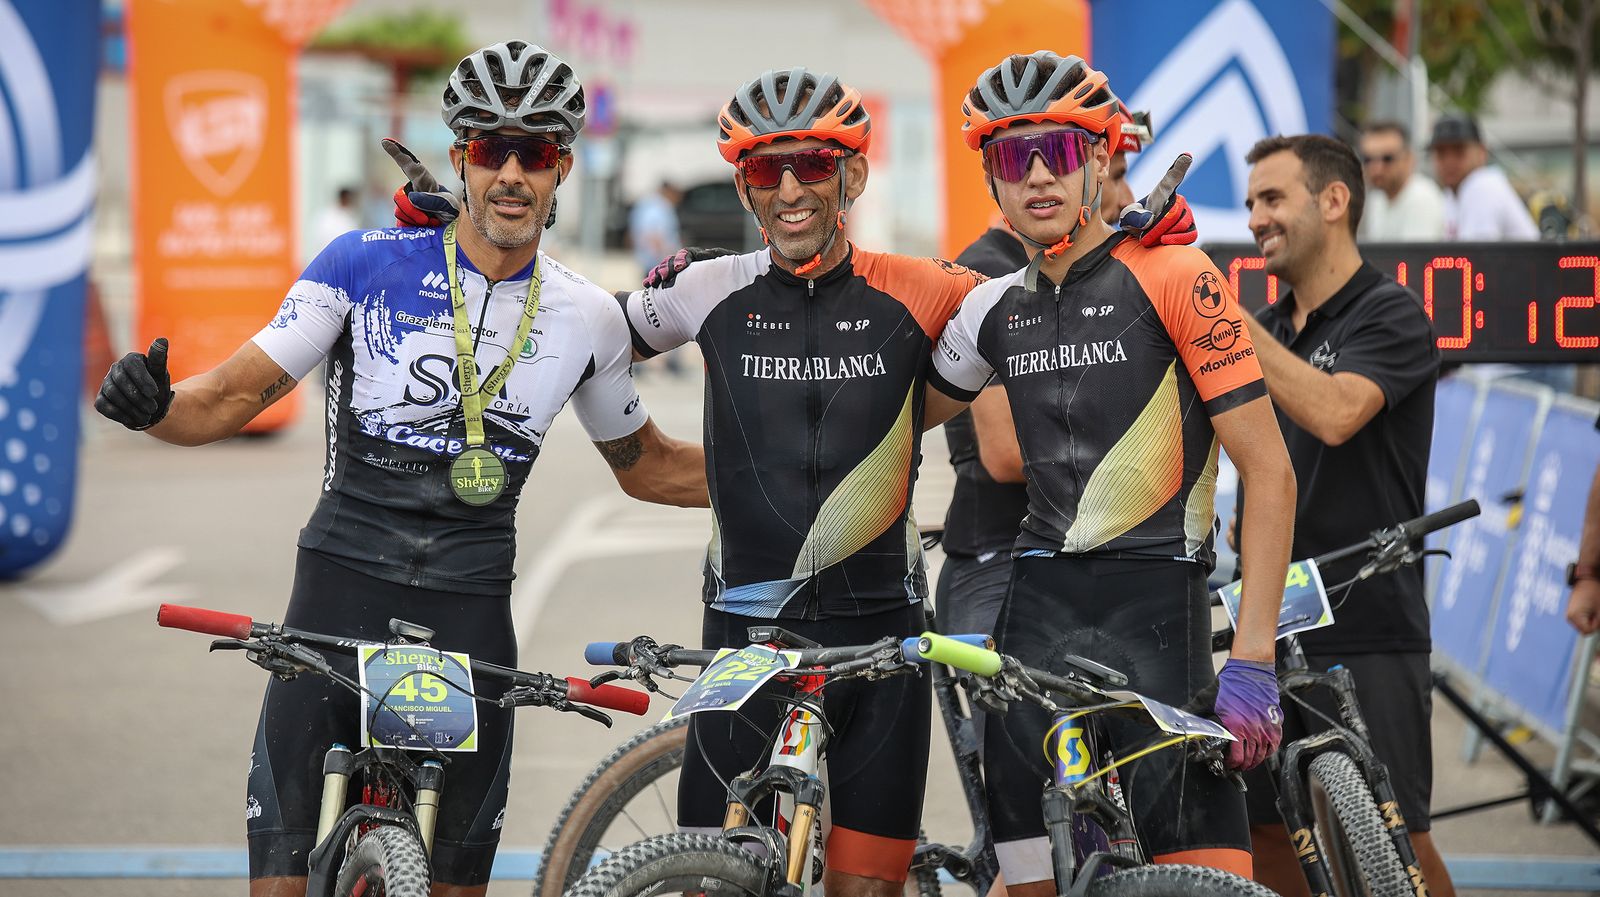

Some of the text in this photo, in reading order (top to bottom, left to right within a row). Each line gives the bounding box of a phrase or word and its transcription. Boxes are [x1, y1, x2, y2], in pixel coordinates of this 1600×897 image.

[418, 288, 448, 301] mobel
[1098, 305, 1115, 317] SP
[469, 323, 498, 339] otor
[747, 320, 791, 330] GEEBEE
[854, 319, 871, 332] SP
[1008, 316, 1042, 330] GEEBEE
[1213, 328, 1234, 344] MINI
[740, 352, 887, 381] TIERRABLANCA
[1005, 340, 1128, 378] TIERRABLANCA
[1199, 347, 1255, 375] Movijerez
[463, 357, 473, 394] Sherry
[486, 361, 513, 392] Sherry
[386, 424, 531, 463] Caceike
[457, 477, 500, 491] Sherry
[385, 650, 447, 671] Sherry
[734, 649, 779, 665] herry
[416, 663, 438, 672] Bike
[388, 671, 448, 703] 45
[384, 705, 425, 713] FRANCISCO
